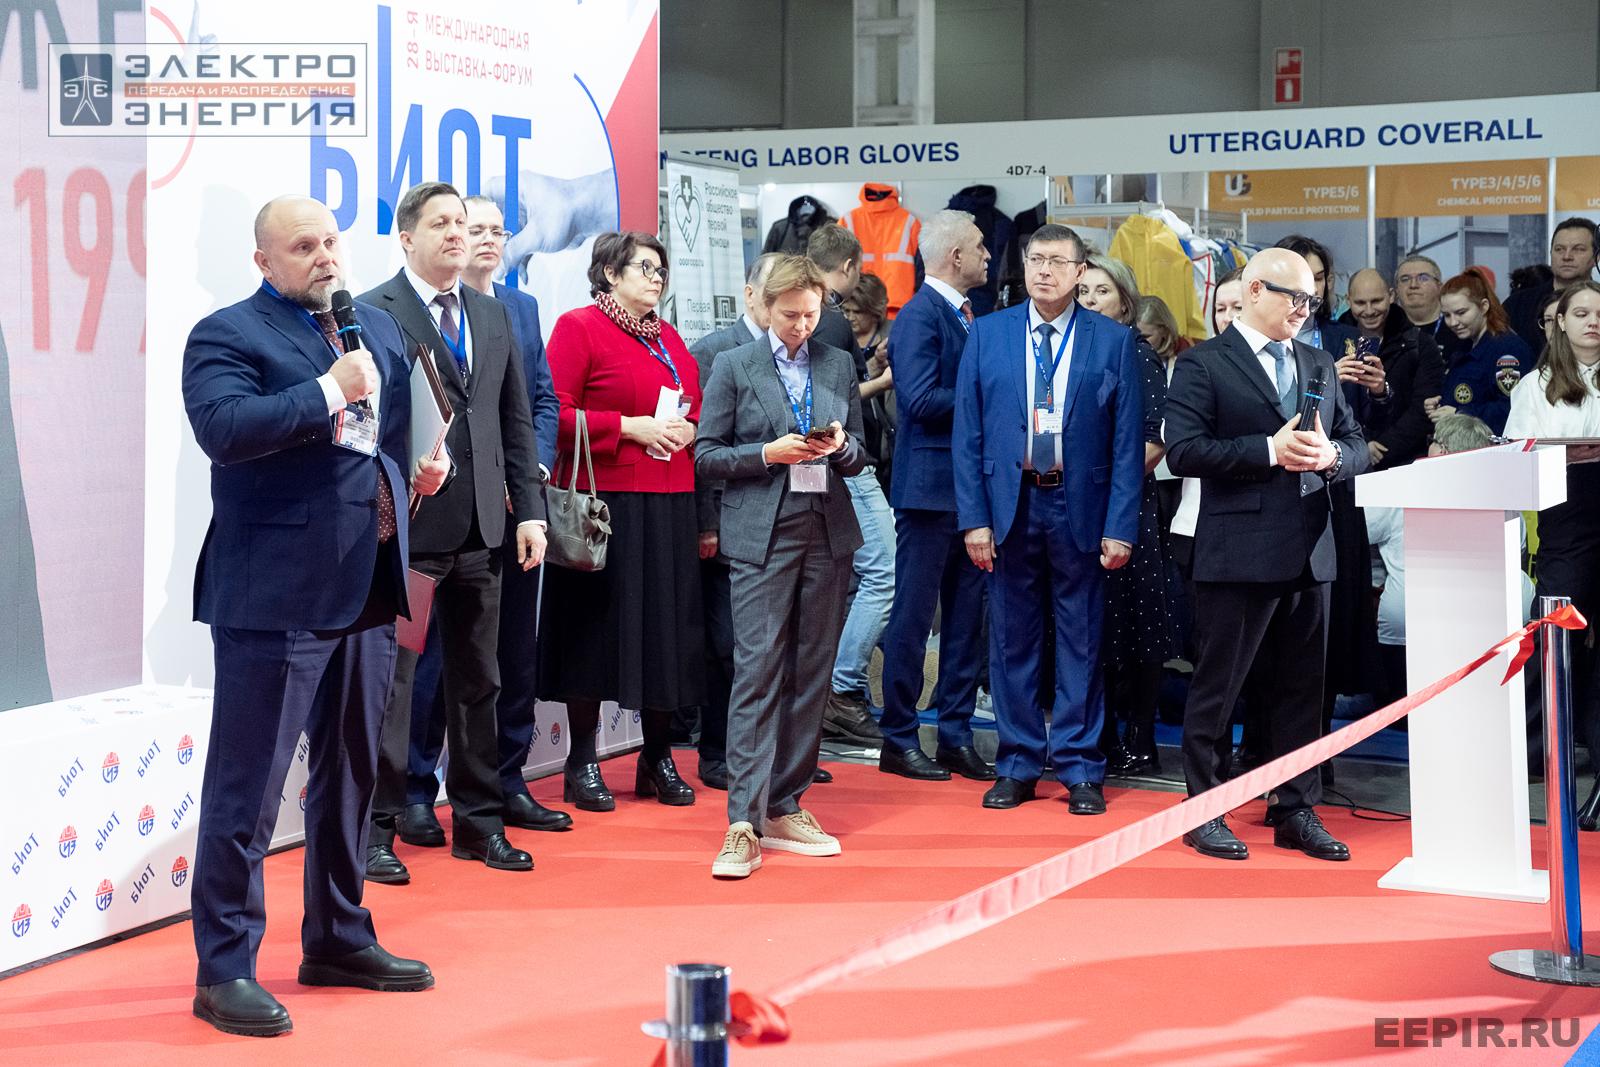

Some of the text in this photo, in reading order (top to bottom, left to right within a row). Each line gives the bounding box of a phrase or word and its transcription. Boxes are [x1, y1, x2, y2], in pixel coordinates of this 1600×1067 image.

[425, 13, 530, 51] МЕЖДУНАРОДНАЯ
[425, 49, 533, 87] ВЫСТАВКА-ФОРУМ
[1169, 118, 1543, 155] UTTERGUARD COVERALL
[768, 147, 850, 168] LABOR
[859, 142, 960, 165] GLOVES
[1006, 165, 1046, 176] 4D7-4
[1452, 174, 1541, 191] TYPE3/4/5/6
[1303, 185, 1359, 200] TYPE5/6
[1438, 194, 1541, 206] CHEMICAL PROTECTION
[1265, 206, 1304, 216] PARTICLE
[1306, 204, 1360, 215] PROTECTION
